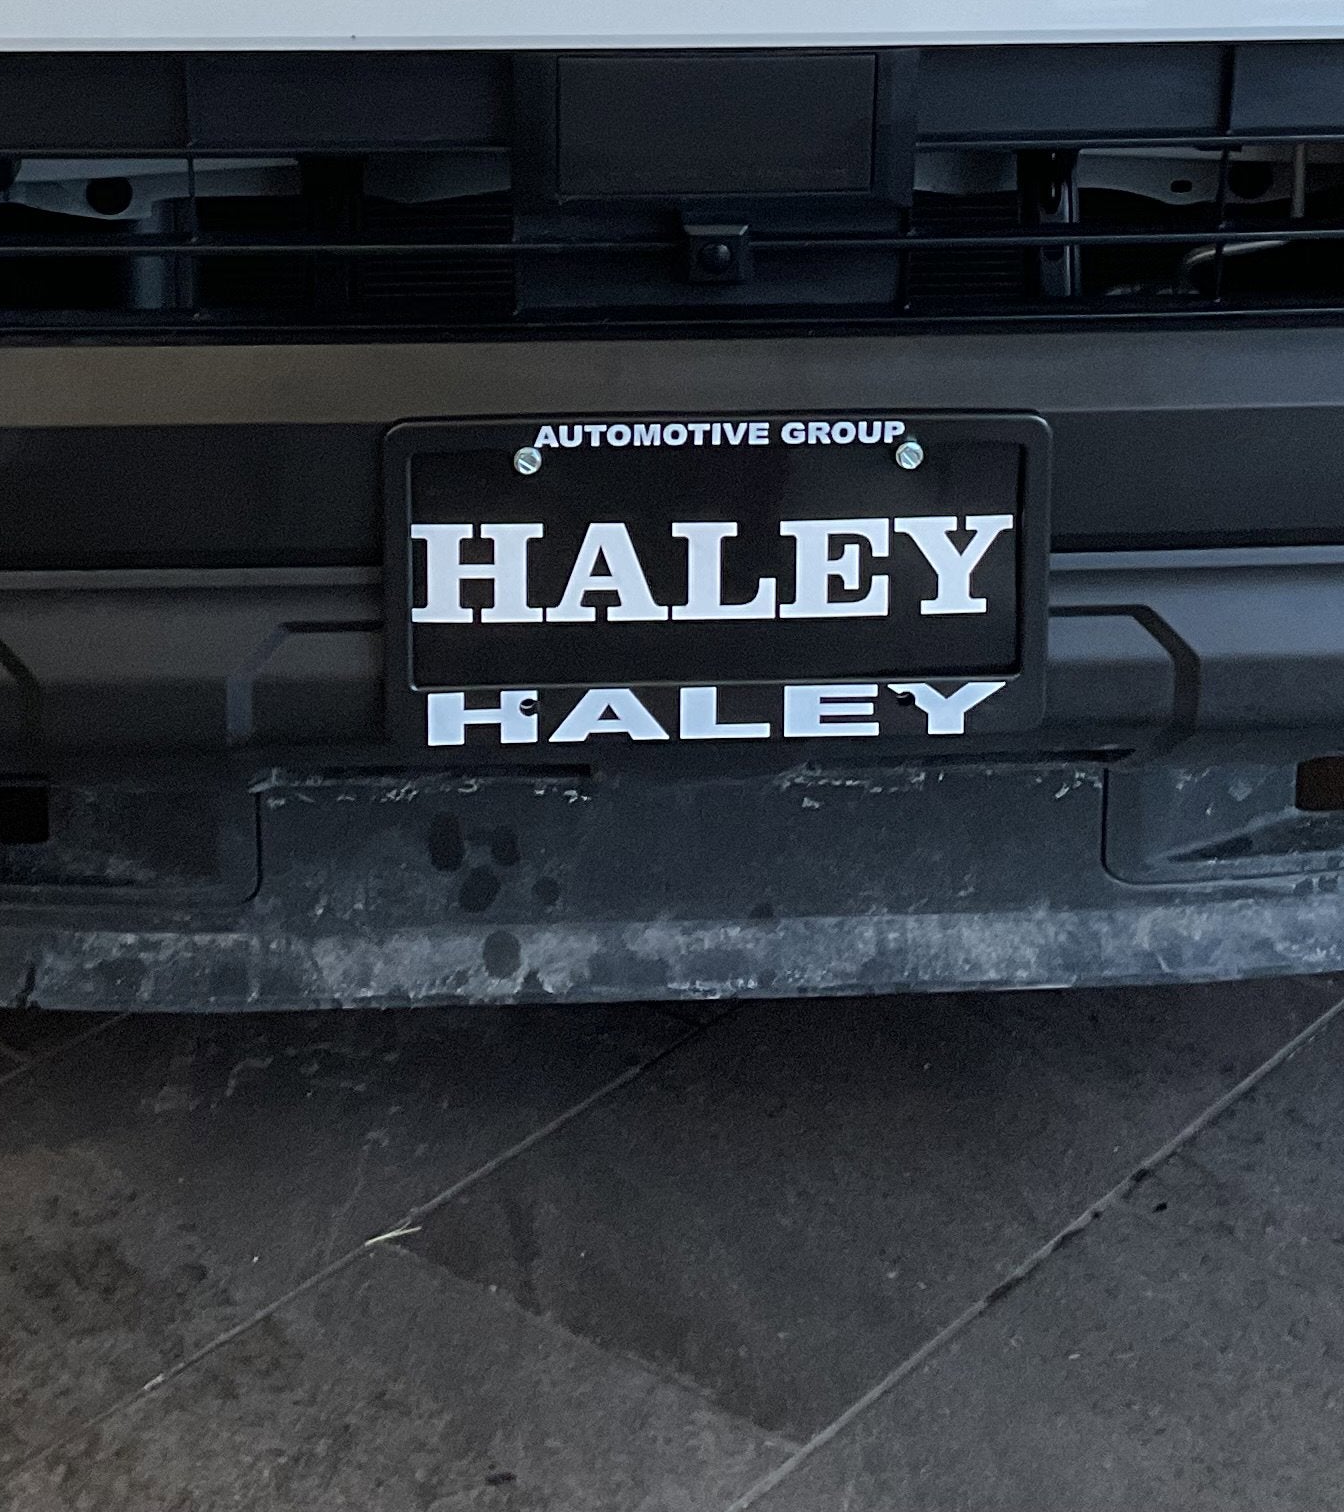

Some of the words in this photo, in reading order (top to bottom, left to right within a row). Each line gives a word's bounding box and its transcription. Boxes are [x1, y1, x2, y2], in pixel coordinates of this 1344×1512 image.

[533, 422, 770, 448] AUTOMOTIVE
[780, 420, 906, 444] GROUP
[410, 514, 1014, 623] HALEY
[427, 681, 1007, 746] HALEY
